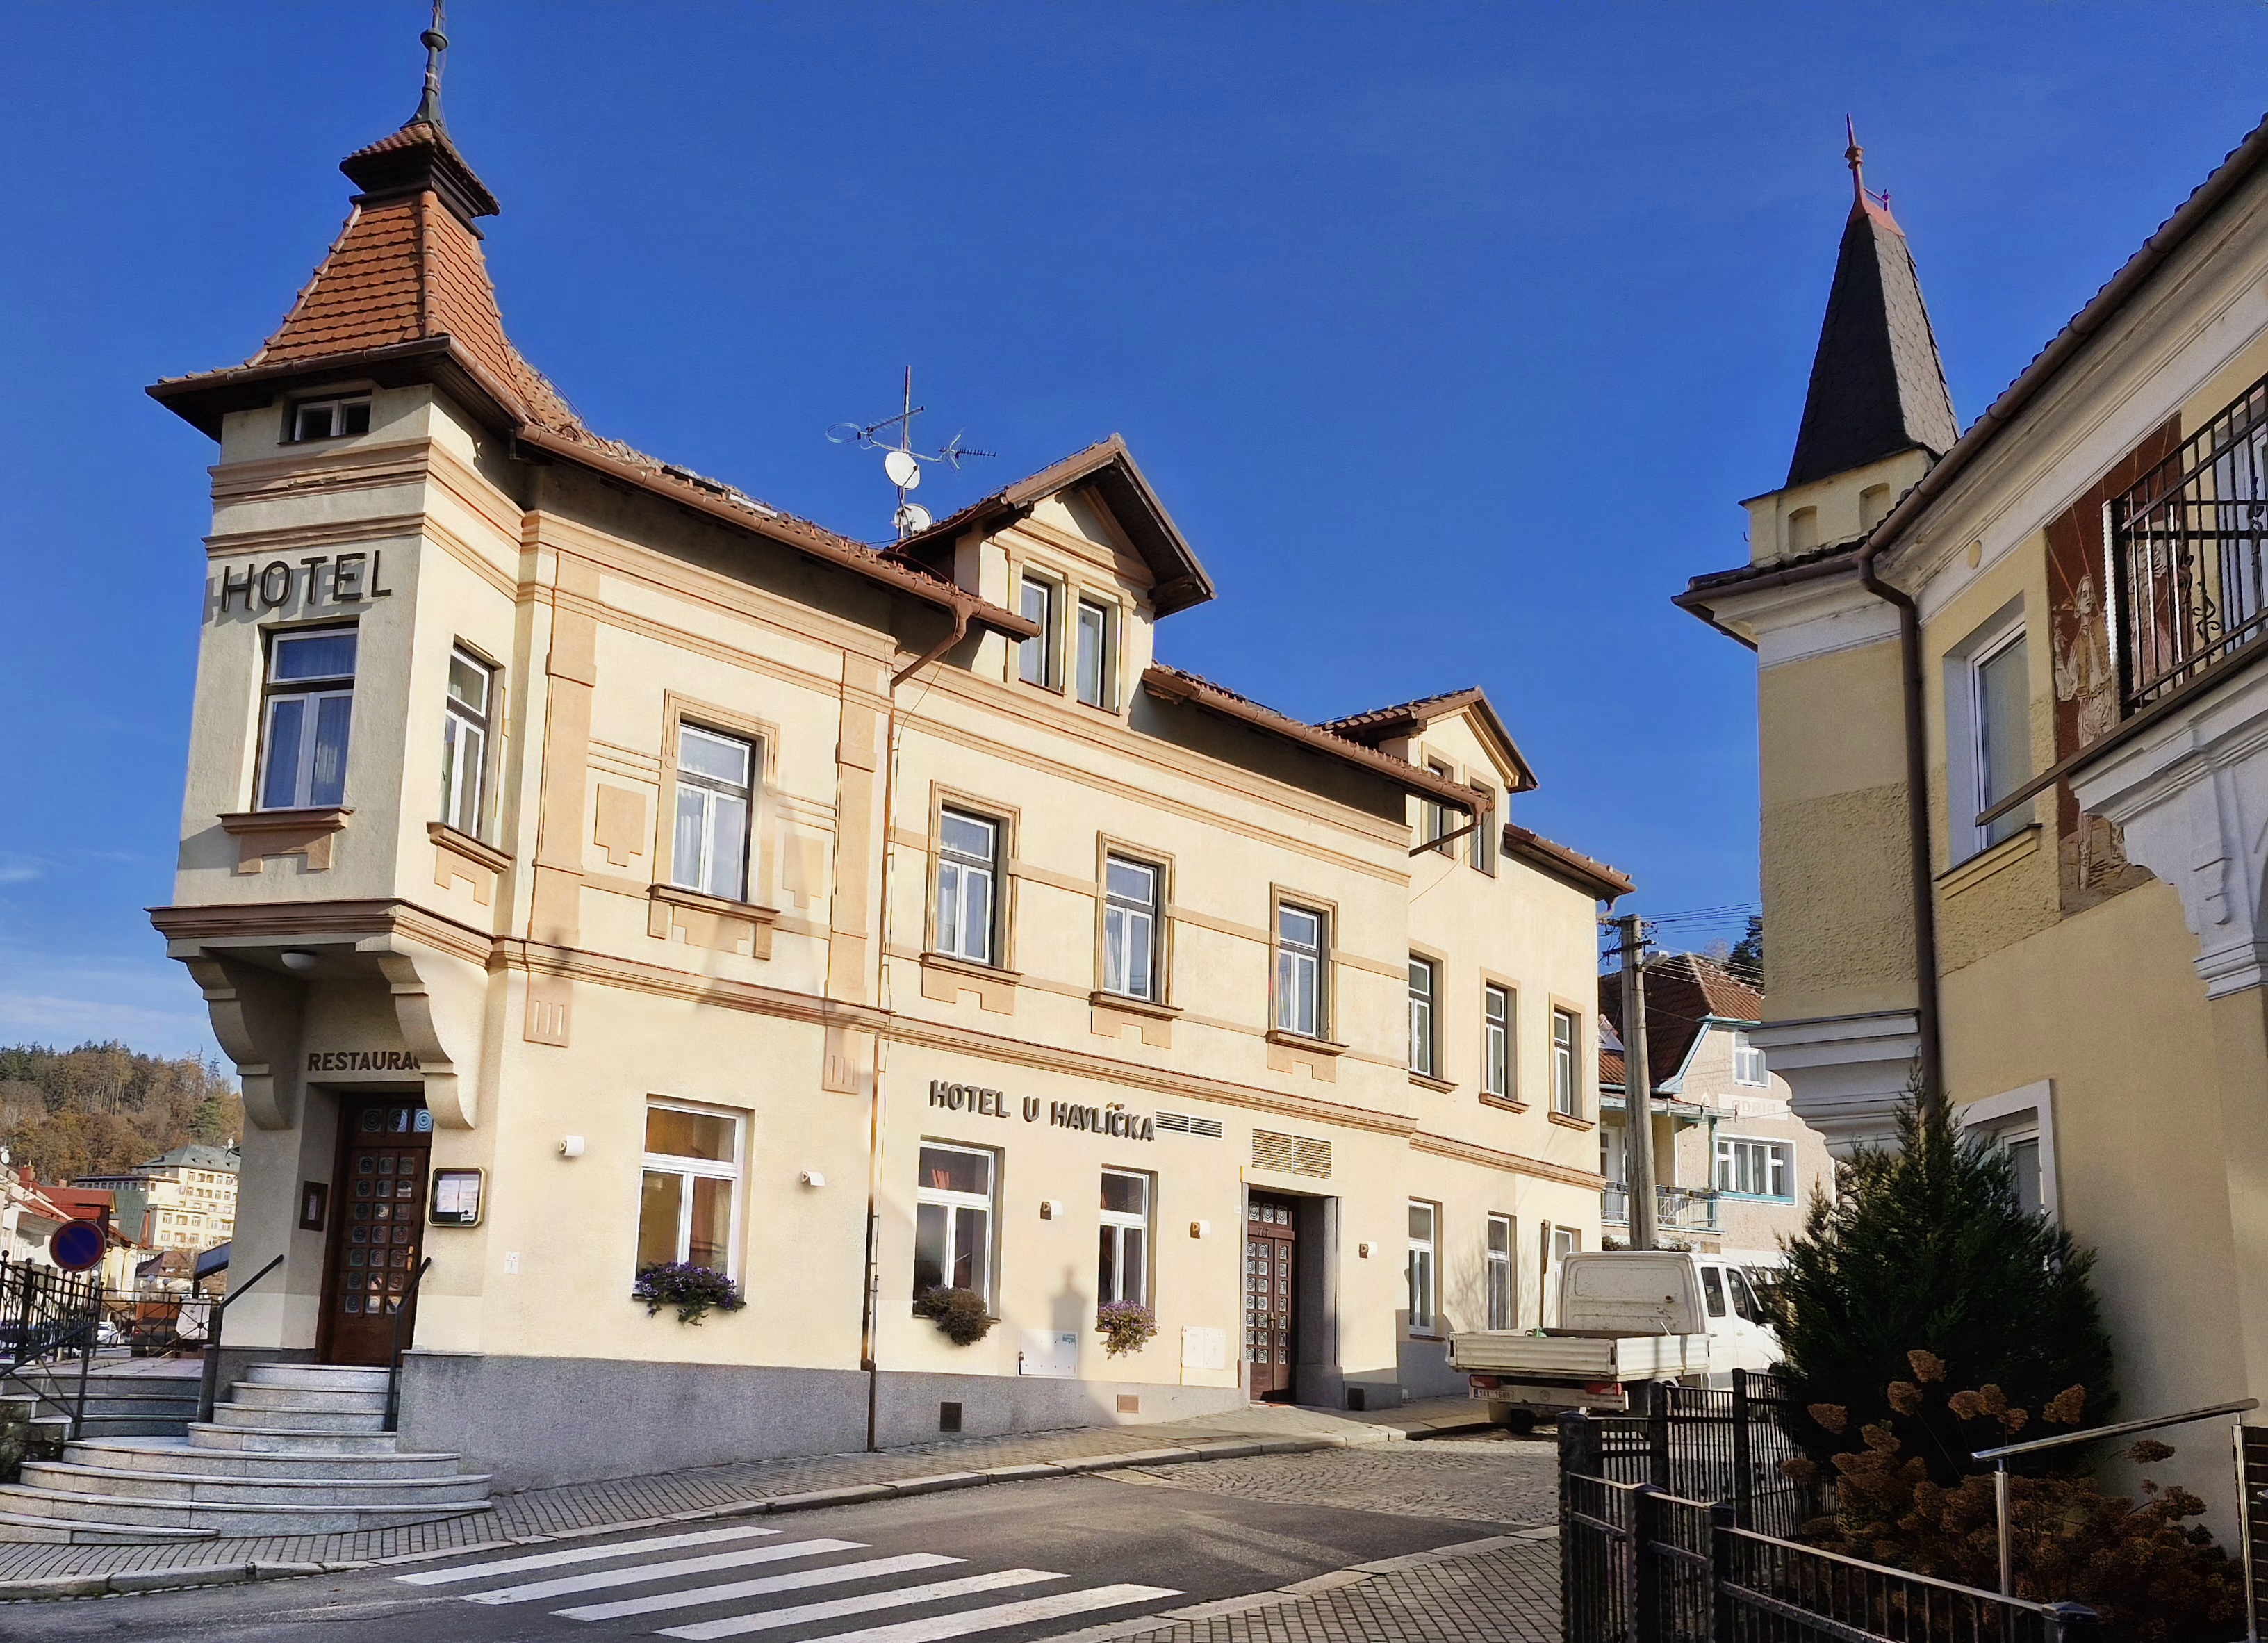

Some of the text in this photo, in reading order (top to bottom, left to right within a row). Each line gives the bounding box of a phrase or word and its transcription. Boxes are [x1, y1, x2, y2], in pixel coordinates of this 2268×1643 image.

[221, 550, 393, 612] HOTEL
[930, 1080, 1155, 1142] HOTEL U HAVLÍČKA
